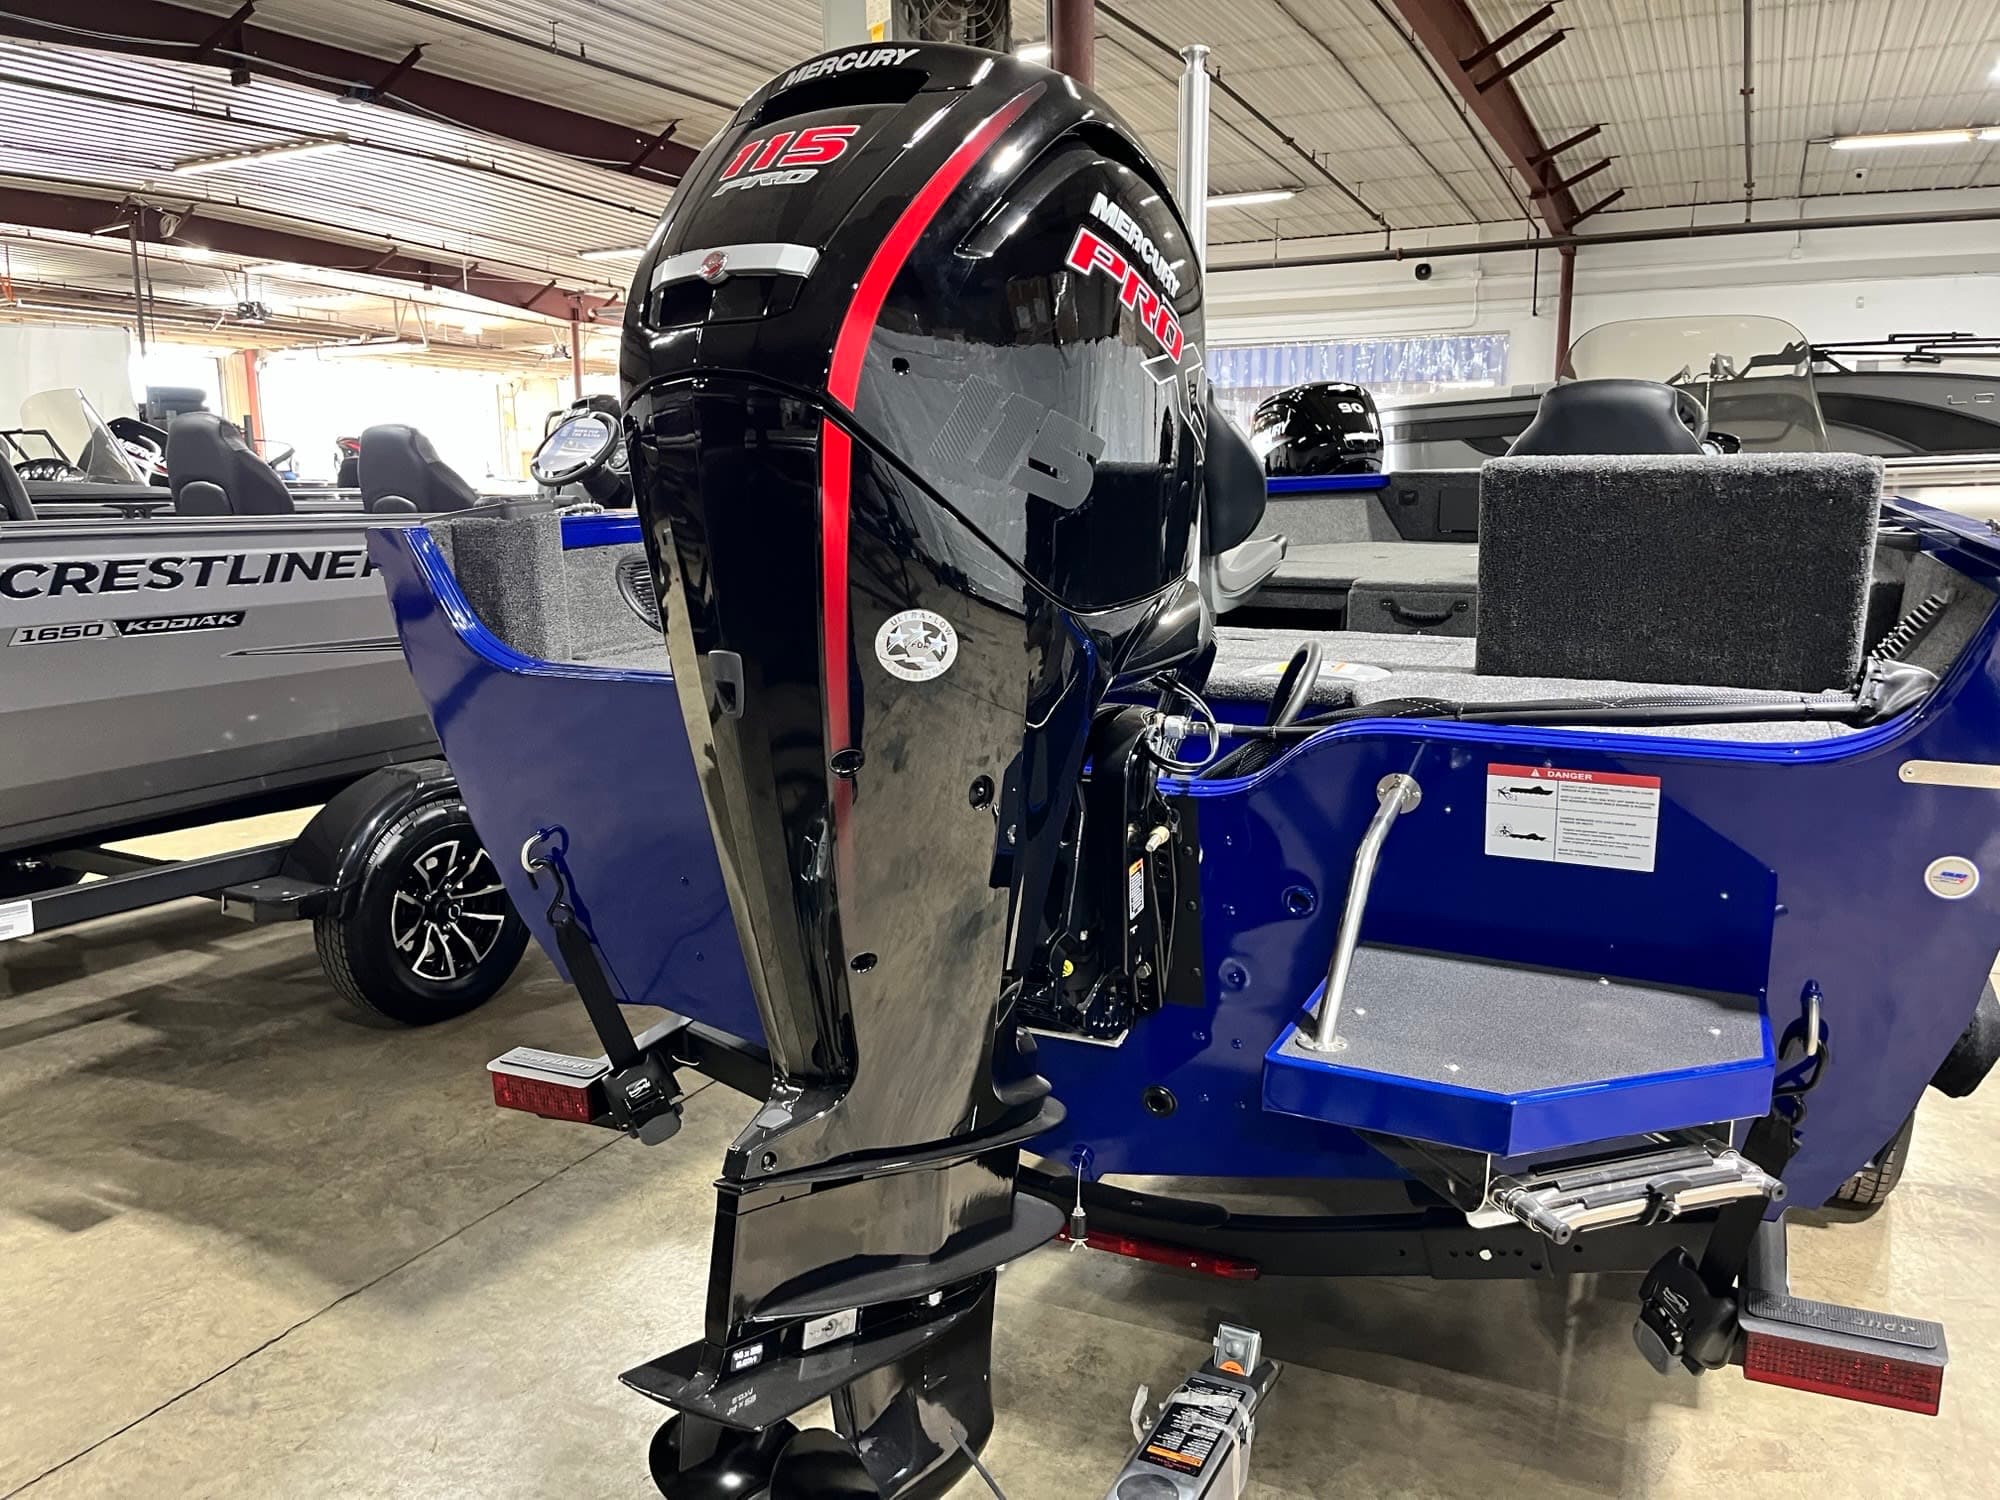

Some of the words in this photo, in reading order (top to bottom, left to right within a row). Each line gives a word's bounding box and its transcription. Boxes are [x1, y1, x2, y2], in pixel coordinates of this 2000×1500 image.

[780, 48, 920, 90] MERCURY
[719, 125, 861, 182] 115
[711, 169, 819, 197] PRO
[1089, 192, 1181, 299] MERCURY
[1065, 224, 1185, 365] PRO
[1337, 402, 1365, 414] 90
[928, 374, 1106, 510] 115
[19, 623, 104, 643] 1650
[124, 613, 240, 633] KODIAK
[1547, 770, 1592, 781] DANGER
